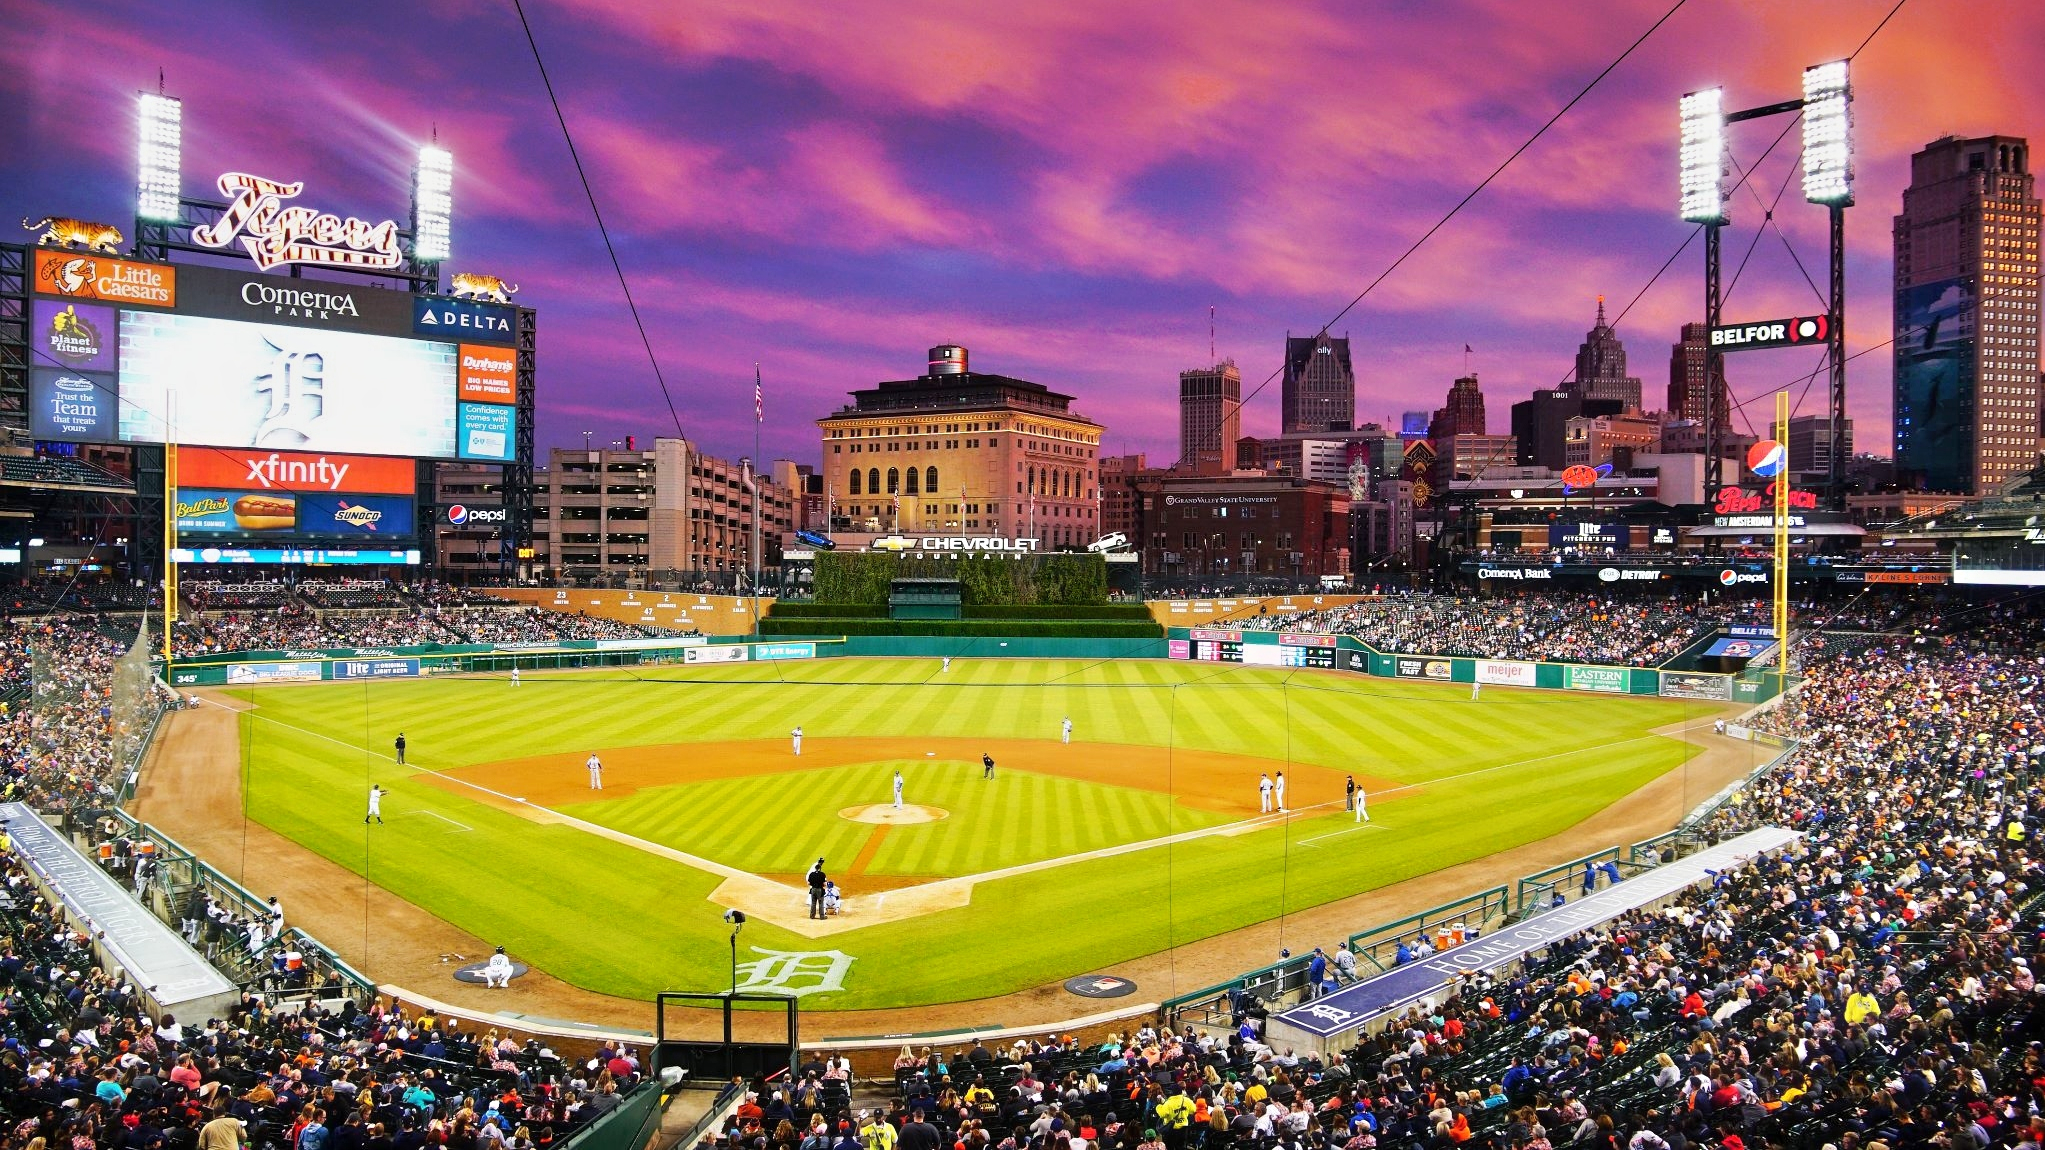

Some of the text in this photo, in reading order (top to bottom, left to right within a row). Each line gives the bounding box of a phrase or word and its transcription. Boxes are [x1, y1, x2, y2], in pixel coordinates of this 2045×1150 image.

[192, 172, 402, 271] Tigers
[113, 264, 161, 287] Little
[98, 277, 169, 301] Caesars
[275, 305, 329, 320] PARK
[444, 311, 510, 332] DELTA
[51, 335, 90, 346] planet
[1711, 324, 1785, 347] BELFOR
[56, 342, 98, 354] fitness
[1316, 346, 1332, 356] ally
[463, 355, 513, 371] Dunham's
[467, 377, 508, 387] BIG NAMES
[465, 384, 510, 394] LOW PRICES
[55, 391, 93, 402] Trust the
[1552, 392, 1568, 400] 1001
[51, 399, 97, 416] Team
[465, 405, 509, 416] Confidence
[53, 415, 96, 425] that treats
[465, 414, 509, 424] comes with
[61, 424, 86, 432] yours
[465, 422, 487, 431] every
[246, 453, 350, 490] xfinity
[176, 497, 230, 518] Ball Park
[337, 511, 380, 521] SUNOCO
[469, 509, 506, 522] pepsi
[1714, 517, 1728, 527] NEW
[1728, 516, 1773, 527] AMSTERDAM
[1579, 522, 1602, 536] Lite
[922, 537, 1040, 551] CHEVROLET
[1525, 568, 1552, 579] Bank
[1621, 570, 1661, 580] DETROIT
[1737, 573, 1767, 583] pepsi
[556, 591, 566, 599] 23
[628, 592, 634, 600] 5
[664, 594, 669, 602] 2
[1313, 596, 1323, 604] 42
[736, 599, 742, 607] 6
[1283, 597, 1291, 605] 11
[644, 607, 653, 616] 47
[1730, 627, 1757, 635] BELLE
[786, 647, 809, 656] Energy
[346, 663, 369, 676] Lite
[1399, 660, 1422, 668] FRESH
[1401, 668, 1419, 676] FAST
[1487, 662, 1523, 678] meijer
[1571, 667, 1622, 681] EASTERN
[1423, 939, 1520, 975] HOME
[1514, 924, 1552, 941] OF
[1546, 905, 1604, 926] THE
